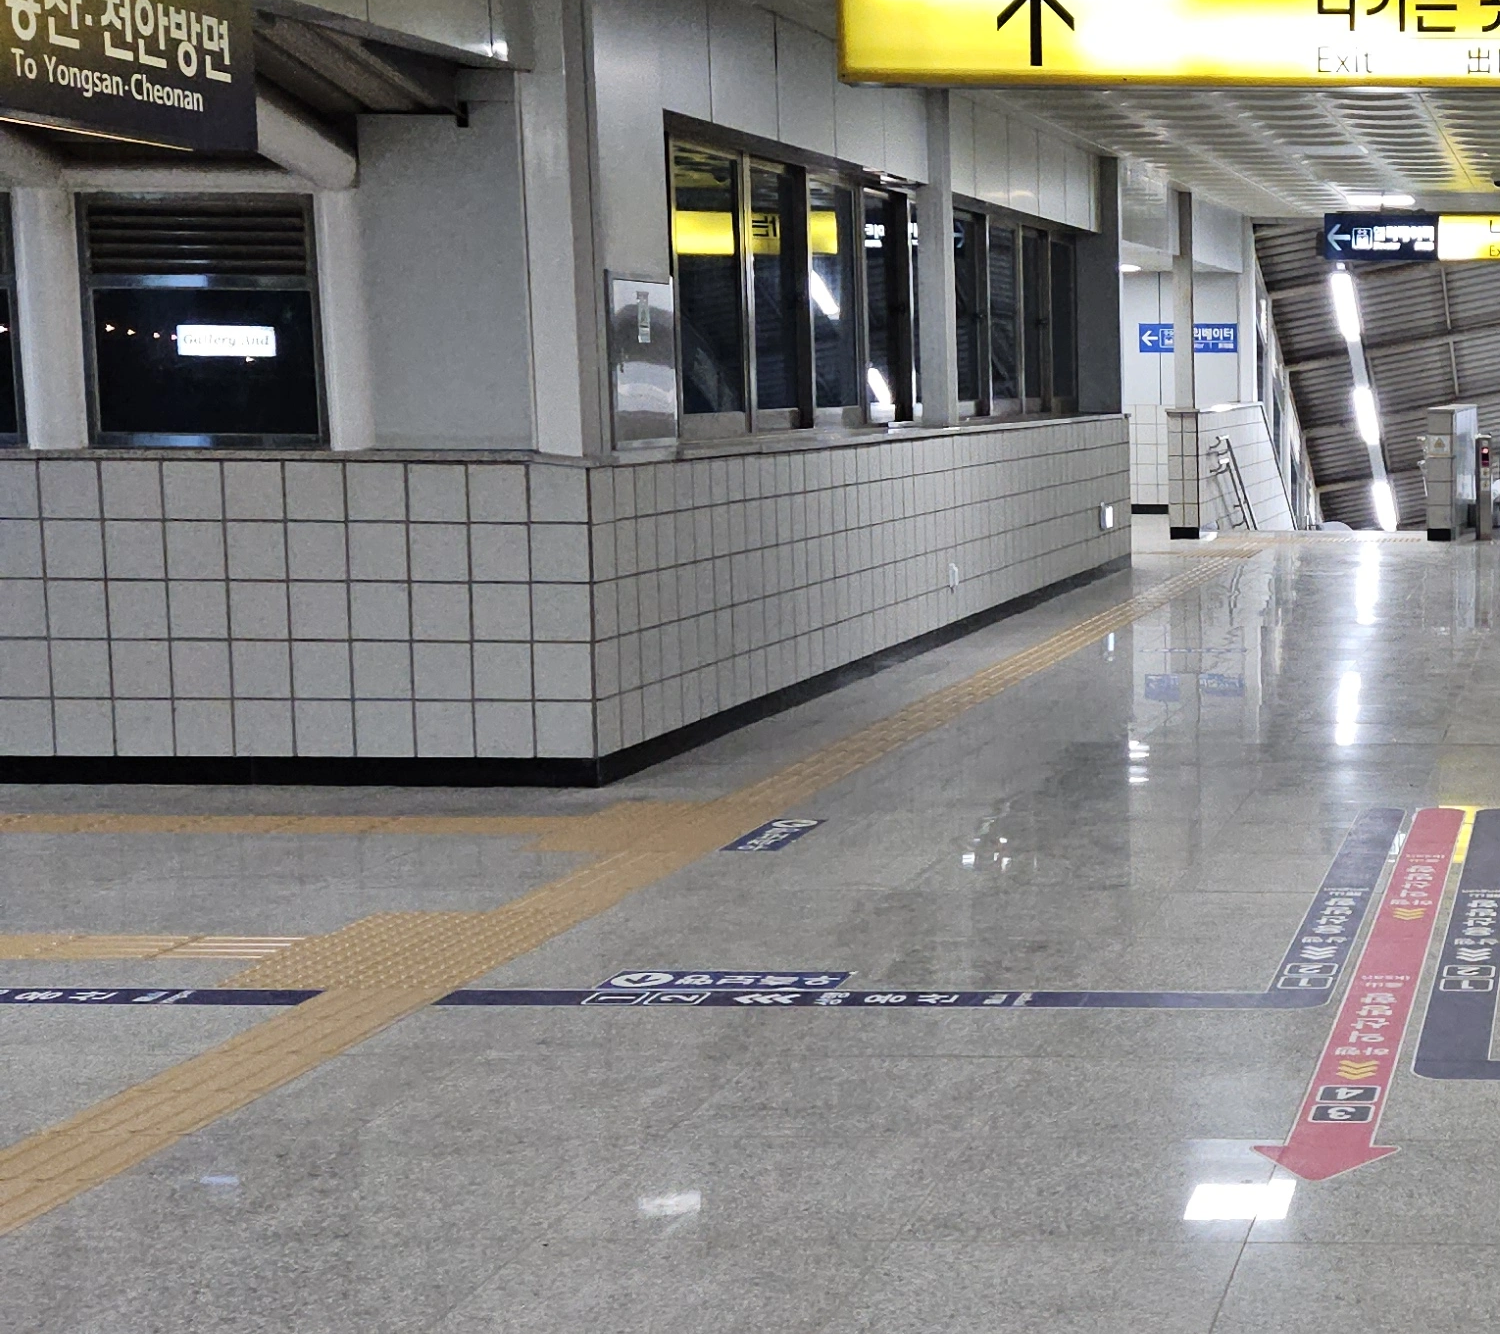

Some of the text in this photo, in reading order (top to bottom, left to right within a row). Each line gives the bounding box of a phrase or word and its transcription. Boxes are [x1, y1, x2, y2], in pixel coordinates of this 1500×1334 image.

[10, 47, 38, 80] To
[1317, 45, 1373, 74] Exit
[1298, 965, 1324, 974] 2
[1456, 966, 1481, 976] 2
[659, 993, 694, 1003] 2
[1334, 1087, 1364, 1100] 4
[1326, 1106, 1356, 1120] 3
